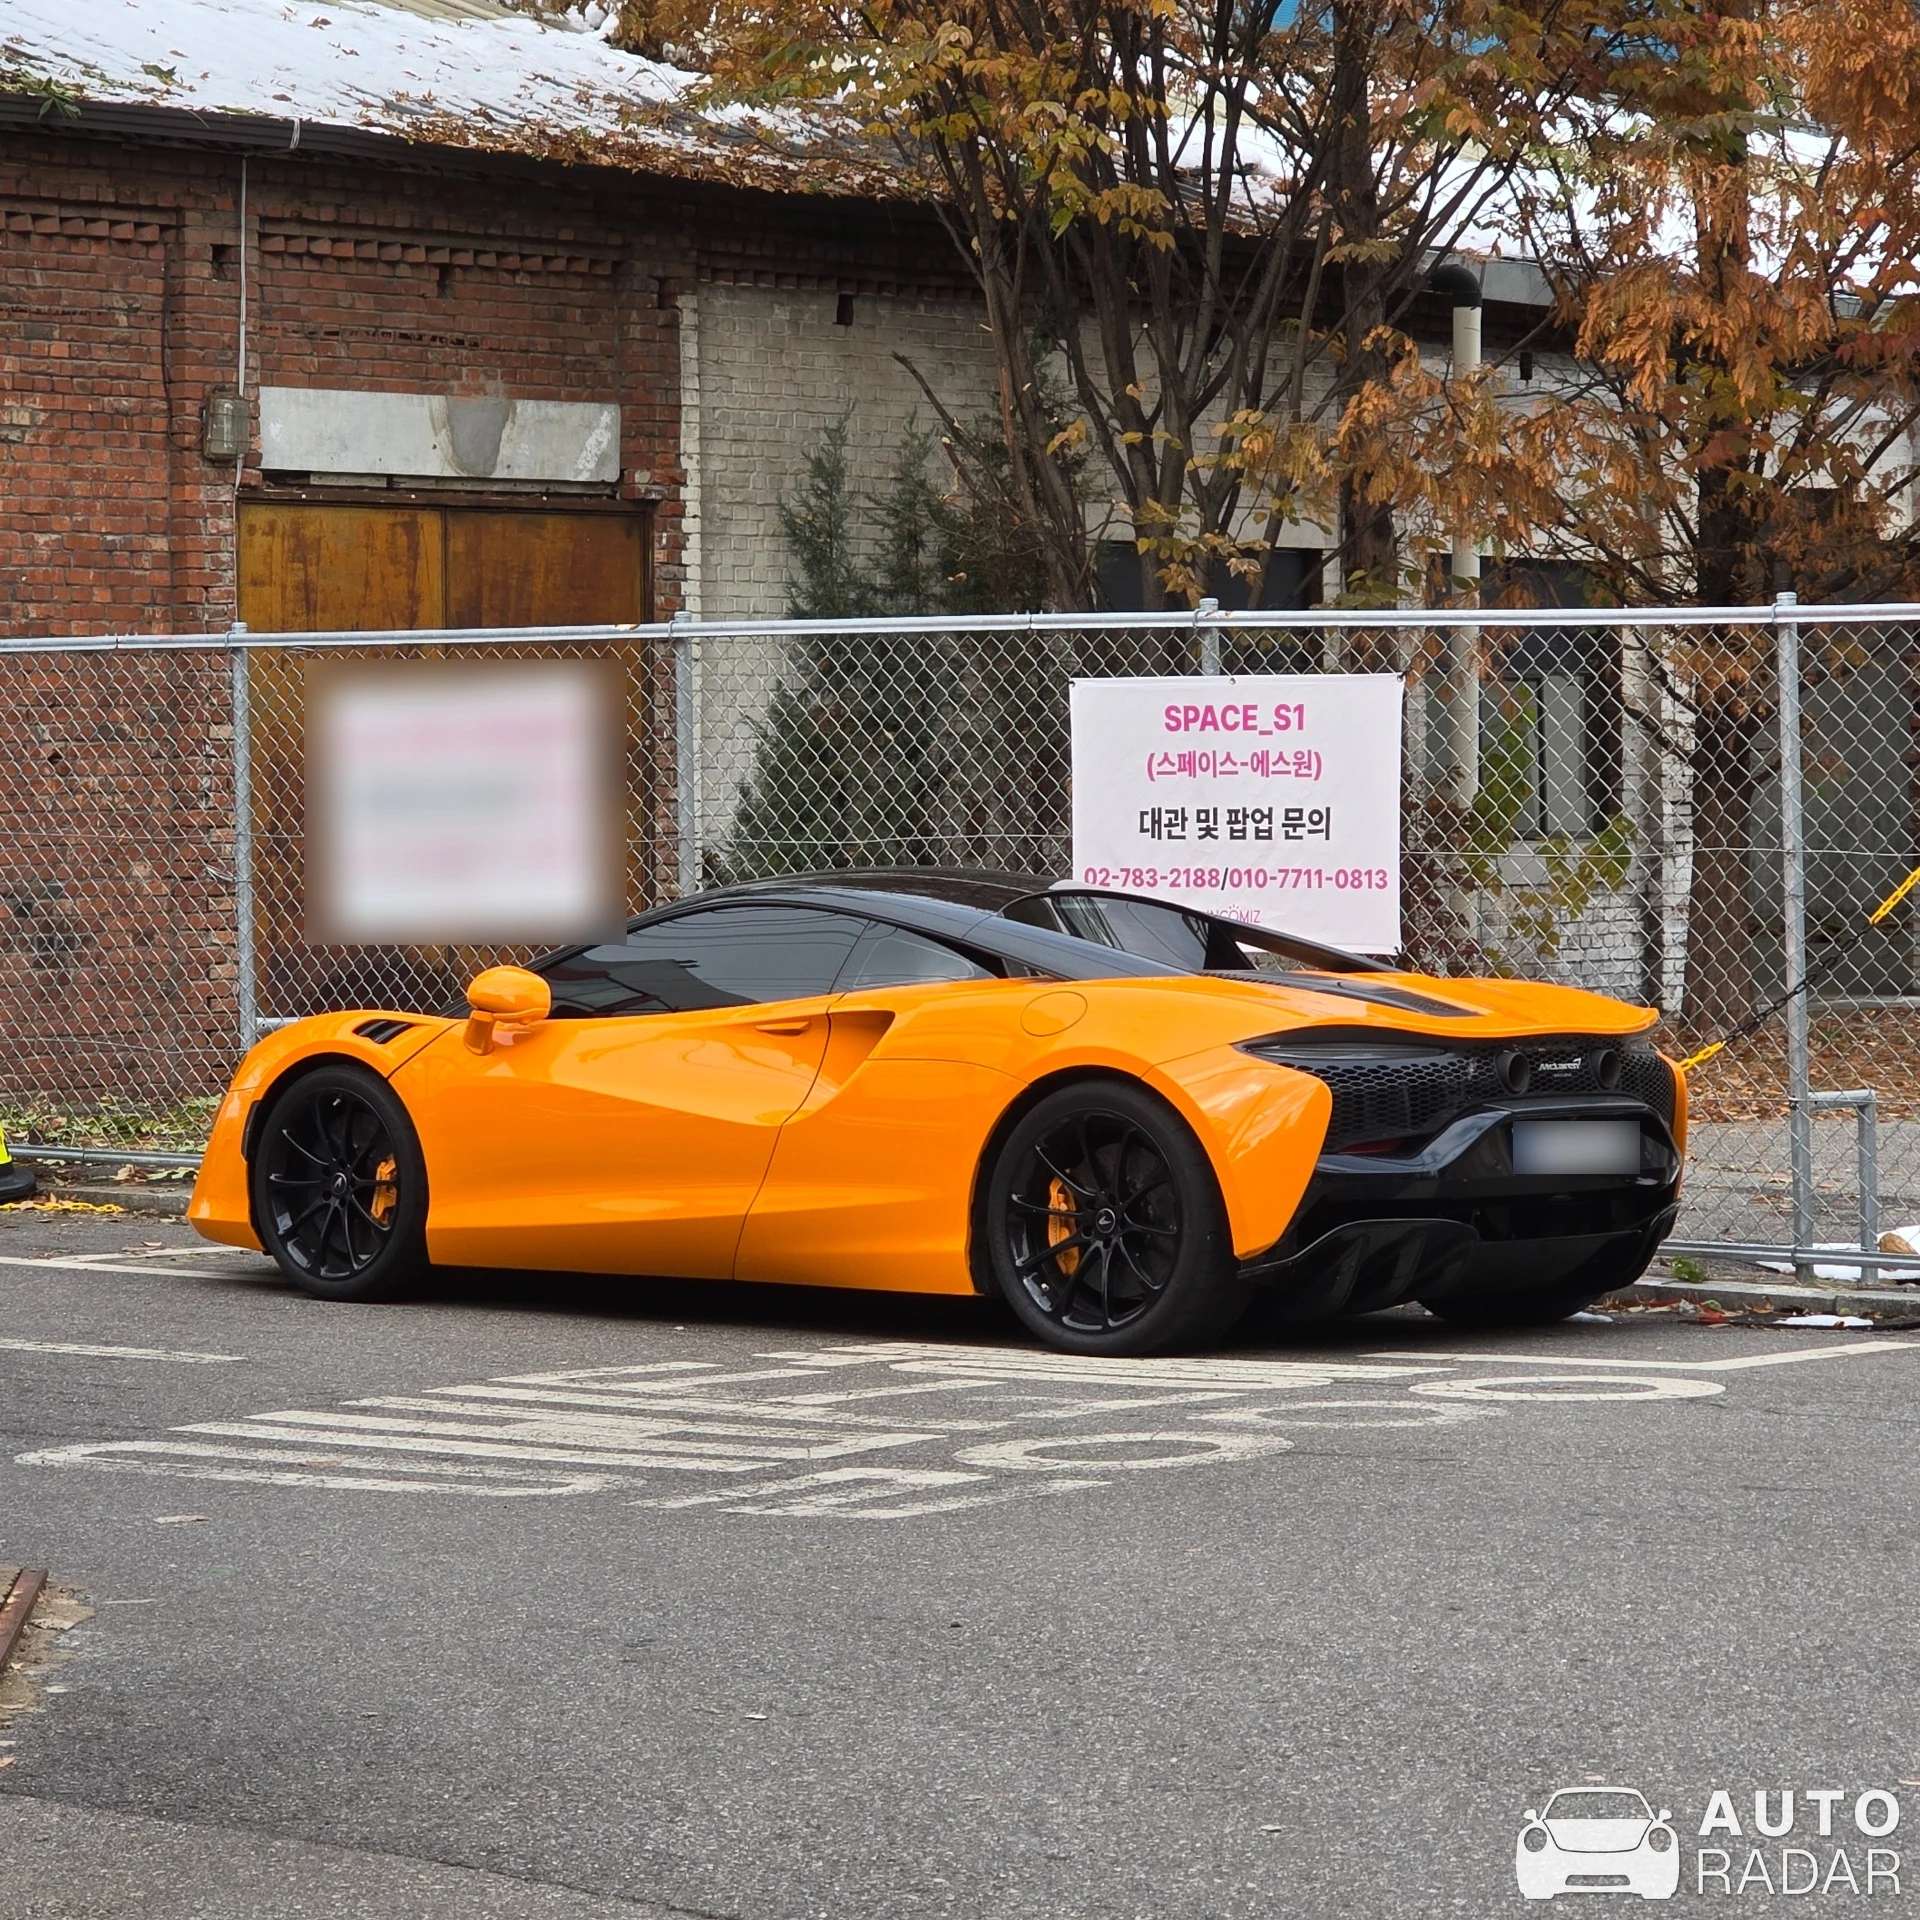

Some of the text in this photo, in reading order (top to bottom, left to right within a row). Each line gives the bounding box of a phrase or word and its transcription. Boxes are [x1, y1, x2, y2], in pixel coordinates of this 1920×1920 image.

[1164, 704, 1305, 736] SPACE_S1
[1147, 750, 1322, 781] (스페이스-에스원)
[1139, 807, 1331, 840] 대관 및 팝업 문의
[1083, 867, 1388, 890] 02-783-2188/010-7711-0813
[1538, 1060, 1581, 1071] McLaren
